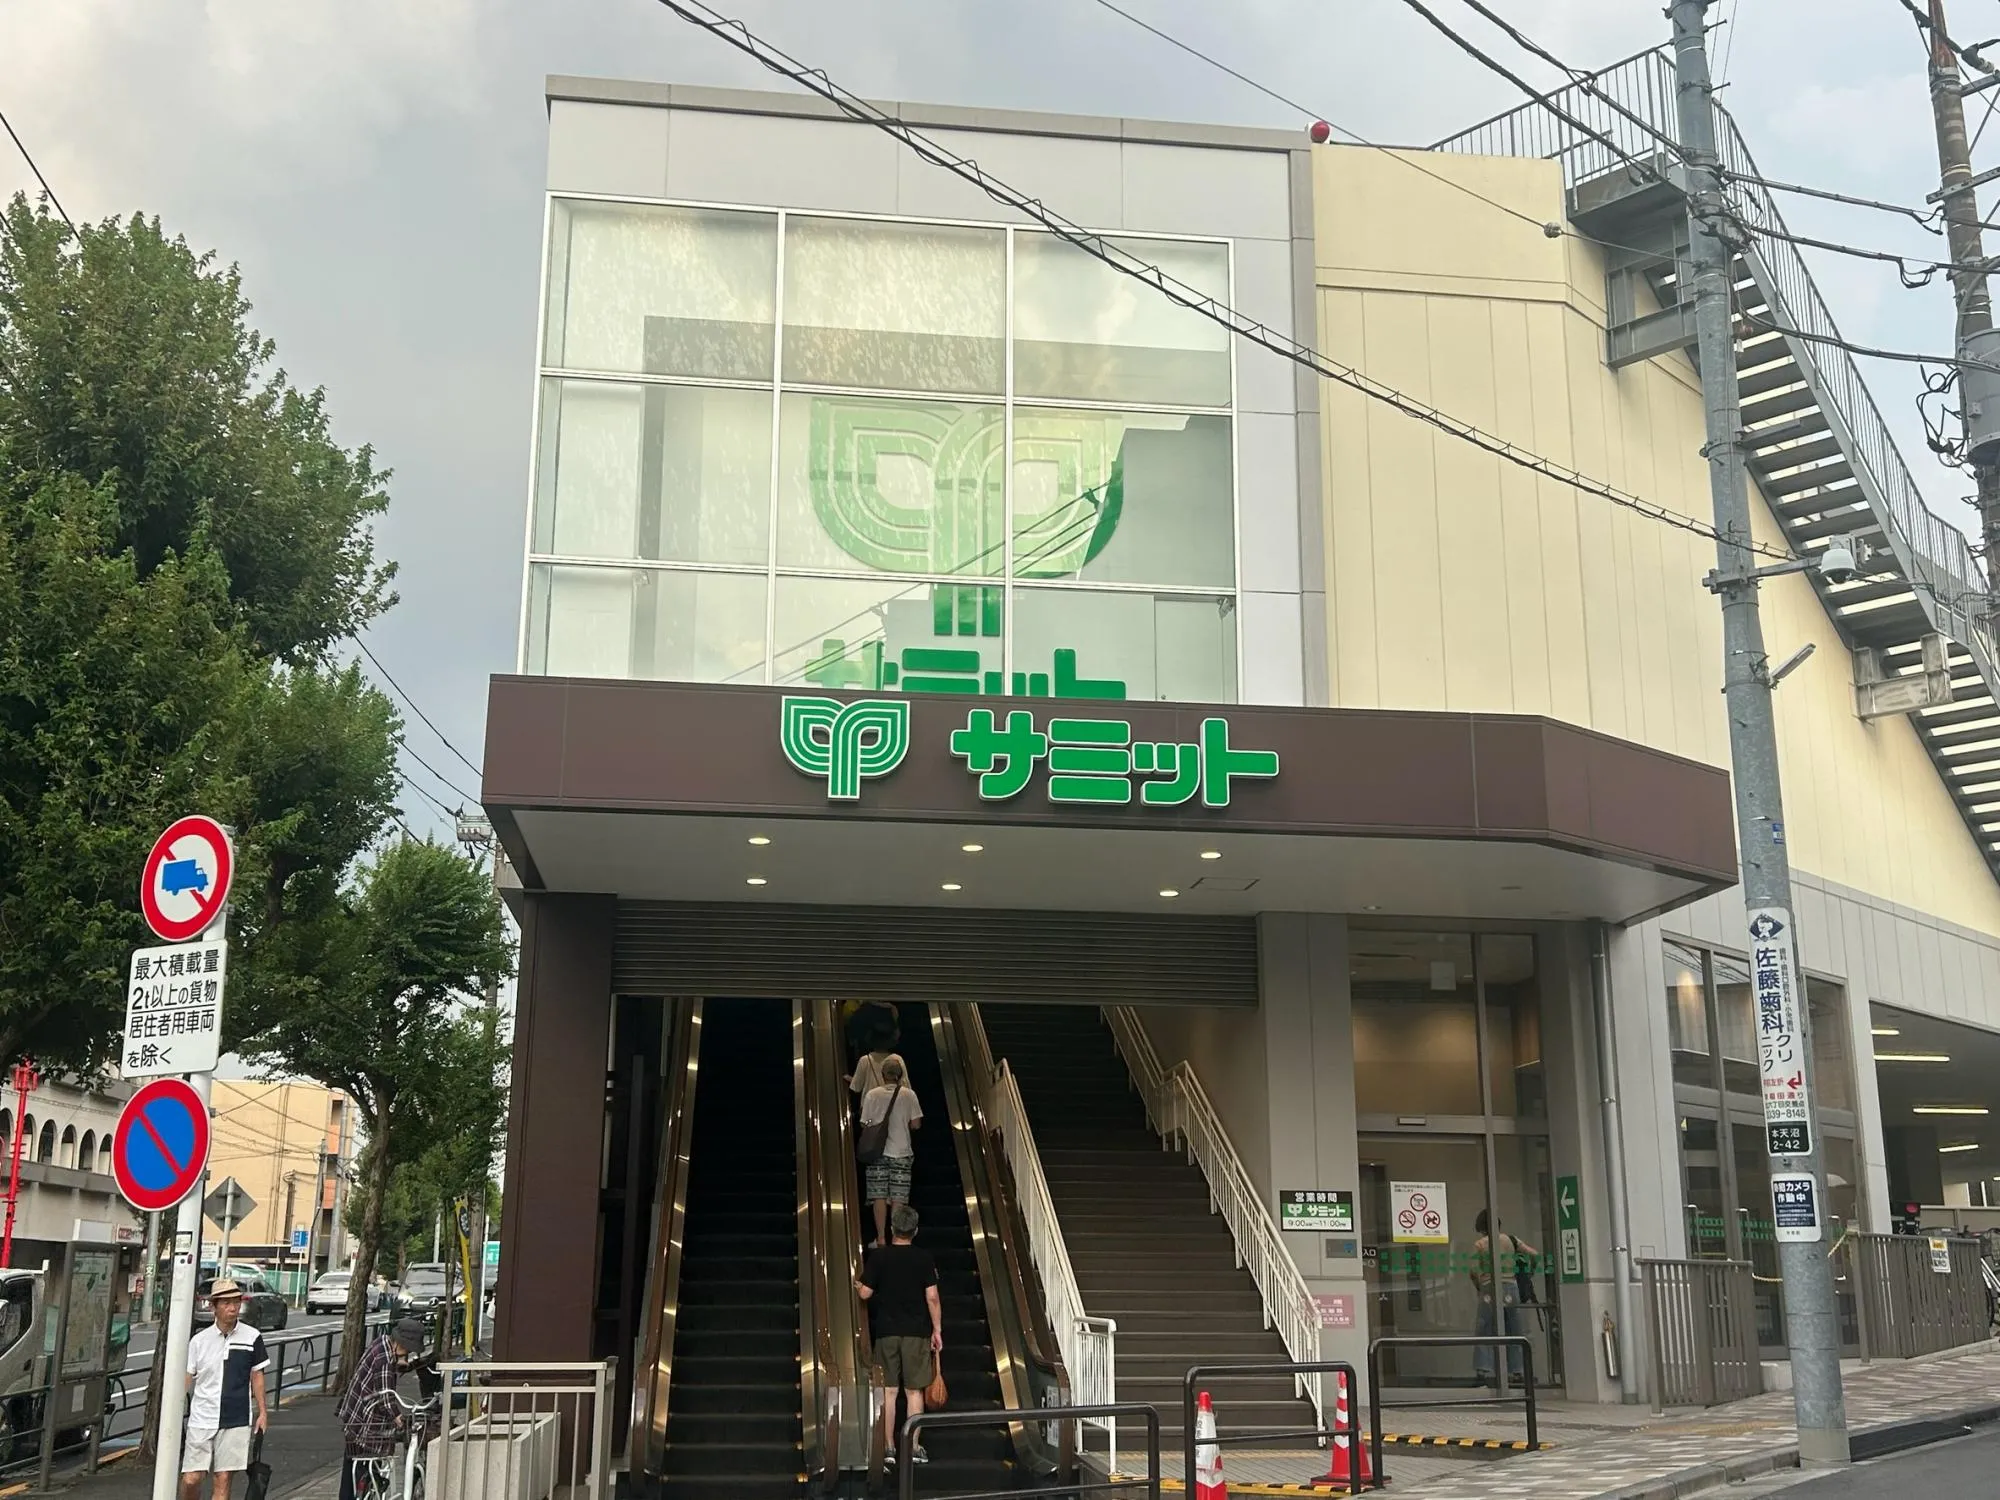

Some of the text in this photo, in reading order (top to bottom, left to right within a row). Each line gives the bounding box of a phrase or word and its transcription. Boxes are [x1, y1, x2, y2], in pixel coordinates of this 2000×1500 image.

[950, 708, 1280, 808] サミット
[134, 949, 219, 980] 最大積載量
[131, 979, 217, 1010] 2t以上の貨物
[1755, 947, 1784, 1035] 佐藤歯科
[129, 1009, 215, 1039] 居住者用車両
[126, 1043, 173, 1068] を除く
[1771, 1128, 1801, 1138] 本天沼
[1772, 1139, 1801, 1151] 2-42
[1295, 1192, 1338, 1203] 営業時間
[1777, 1192, 1806, 1203] 作動中
[1307, 1204, 1346, 1217] サミット
